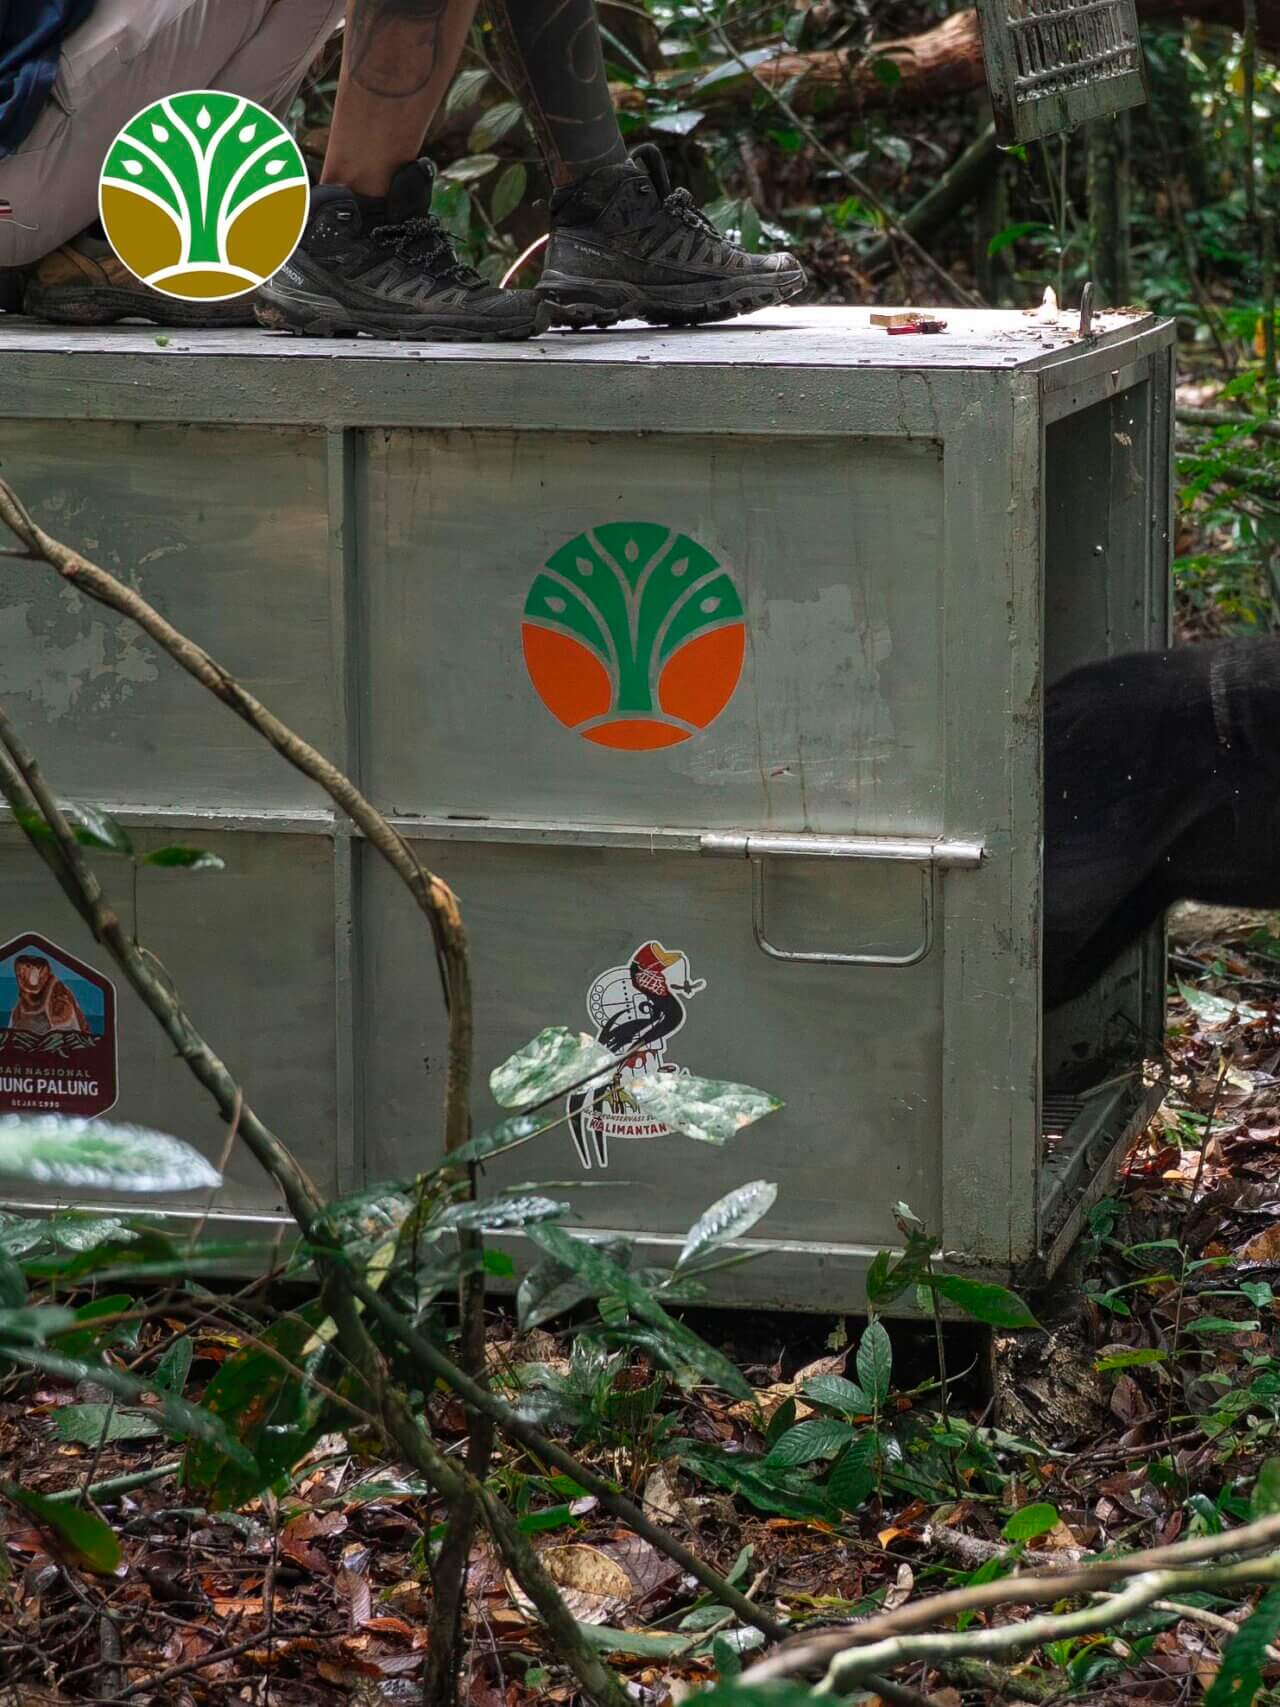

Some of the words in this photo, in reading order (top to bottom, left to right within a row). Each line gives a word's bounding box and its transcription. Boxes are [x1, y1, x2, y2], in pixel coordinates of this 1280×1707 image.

[24, 1067, 91, 1078] NASIONAL
[37, 1079, 99, 1096] PALUNG
[590, 1117, 667, 1136] KALIMANTAN
